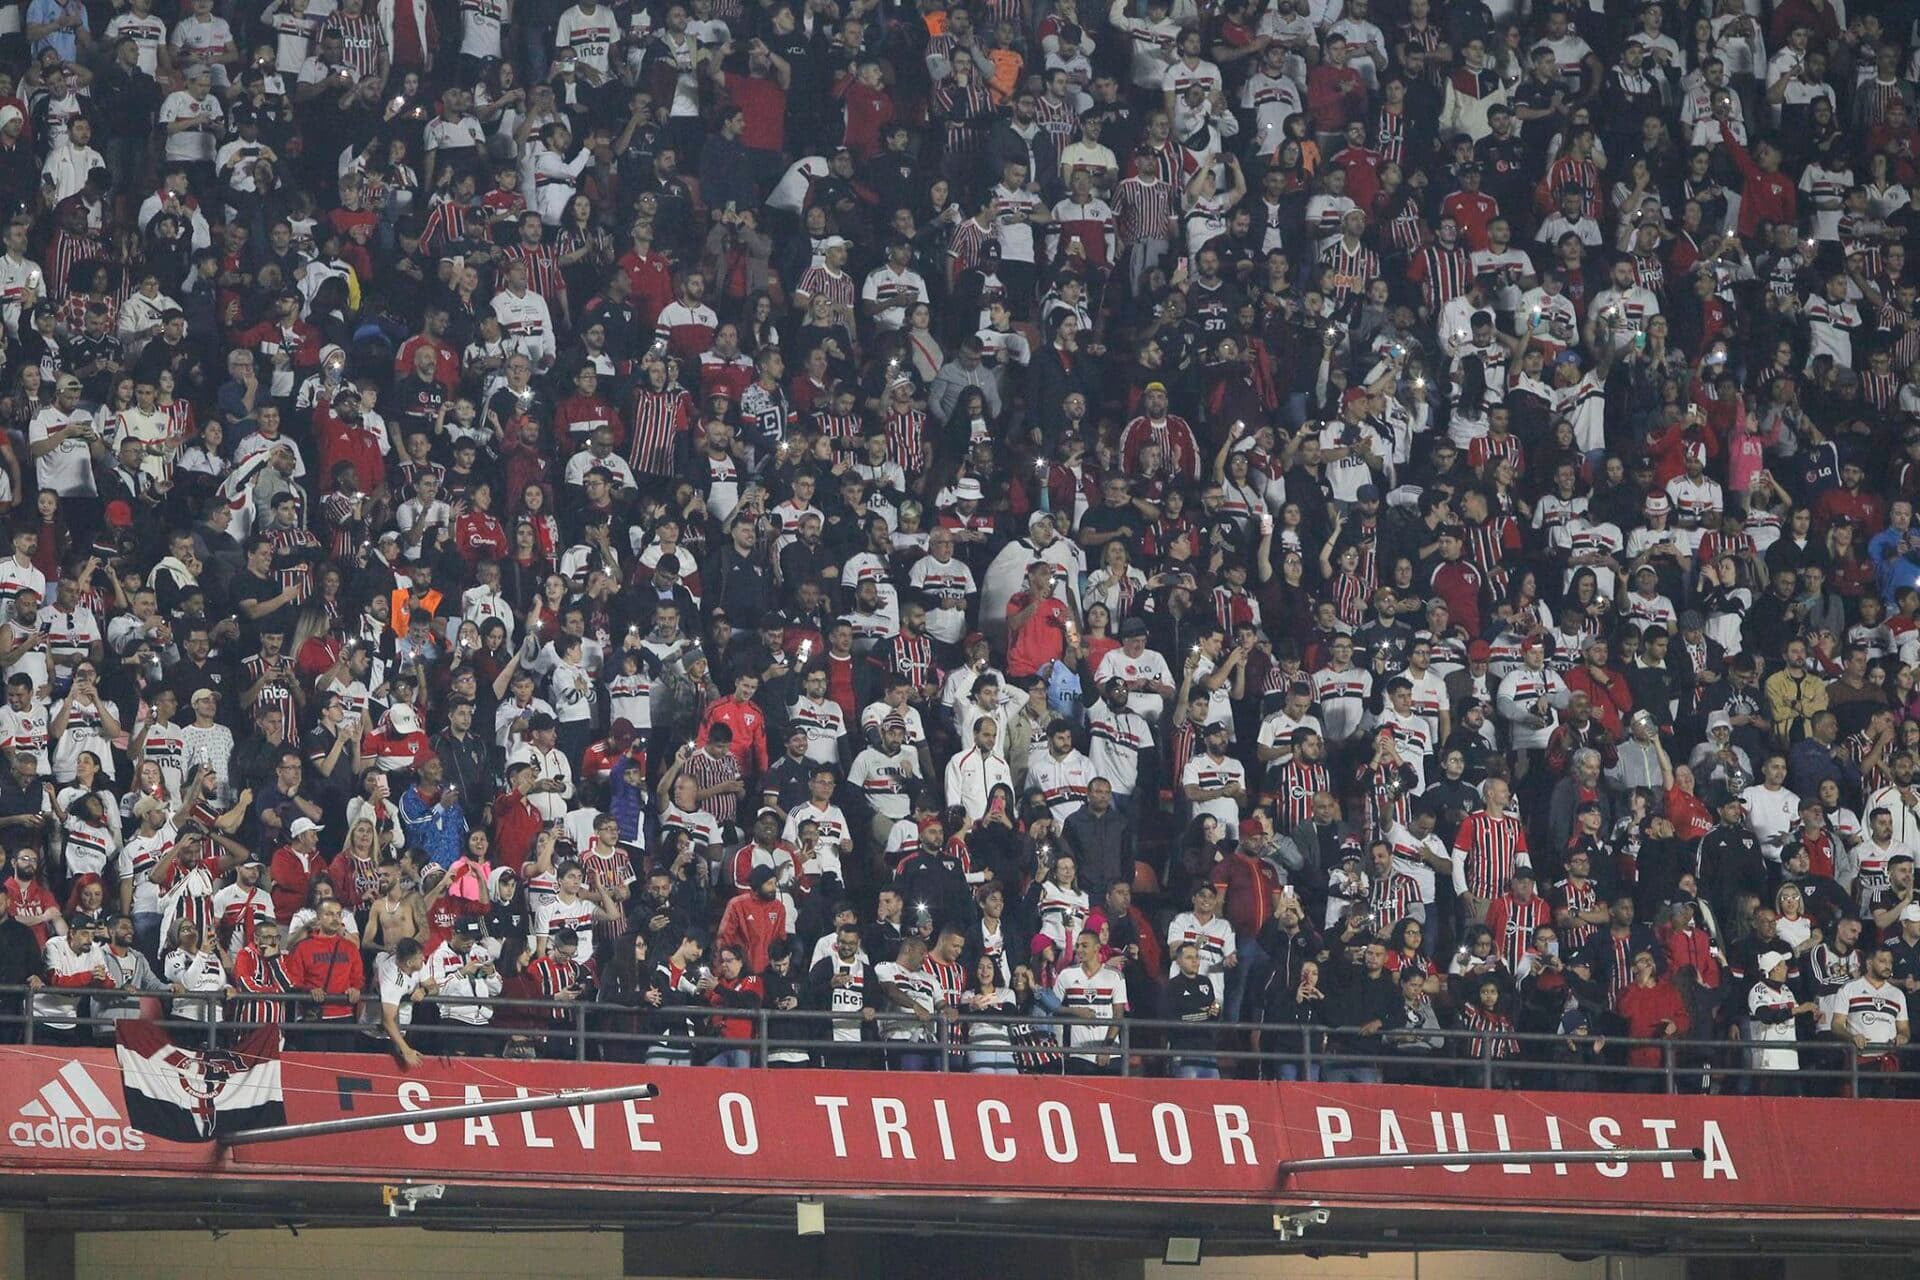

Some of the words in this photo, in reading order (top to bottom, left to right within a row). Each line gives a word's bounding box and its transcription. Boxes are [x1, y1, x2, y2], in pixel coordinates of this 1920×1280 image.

[429, 394, 441, 403] LG
[1818, 467, 1831, 477] LG
[8, 1116, 146, 1151] adidas
[397, 1081, 662, 1152] SALVE
[719, 1092, 759, 1156] O
[813, 1096, 1260, 1167] TRICOLOR
[1315, 1106, 1739, 1180] PAULISTA
